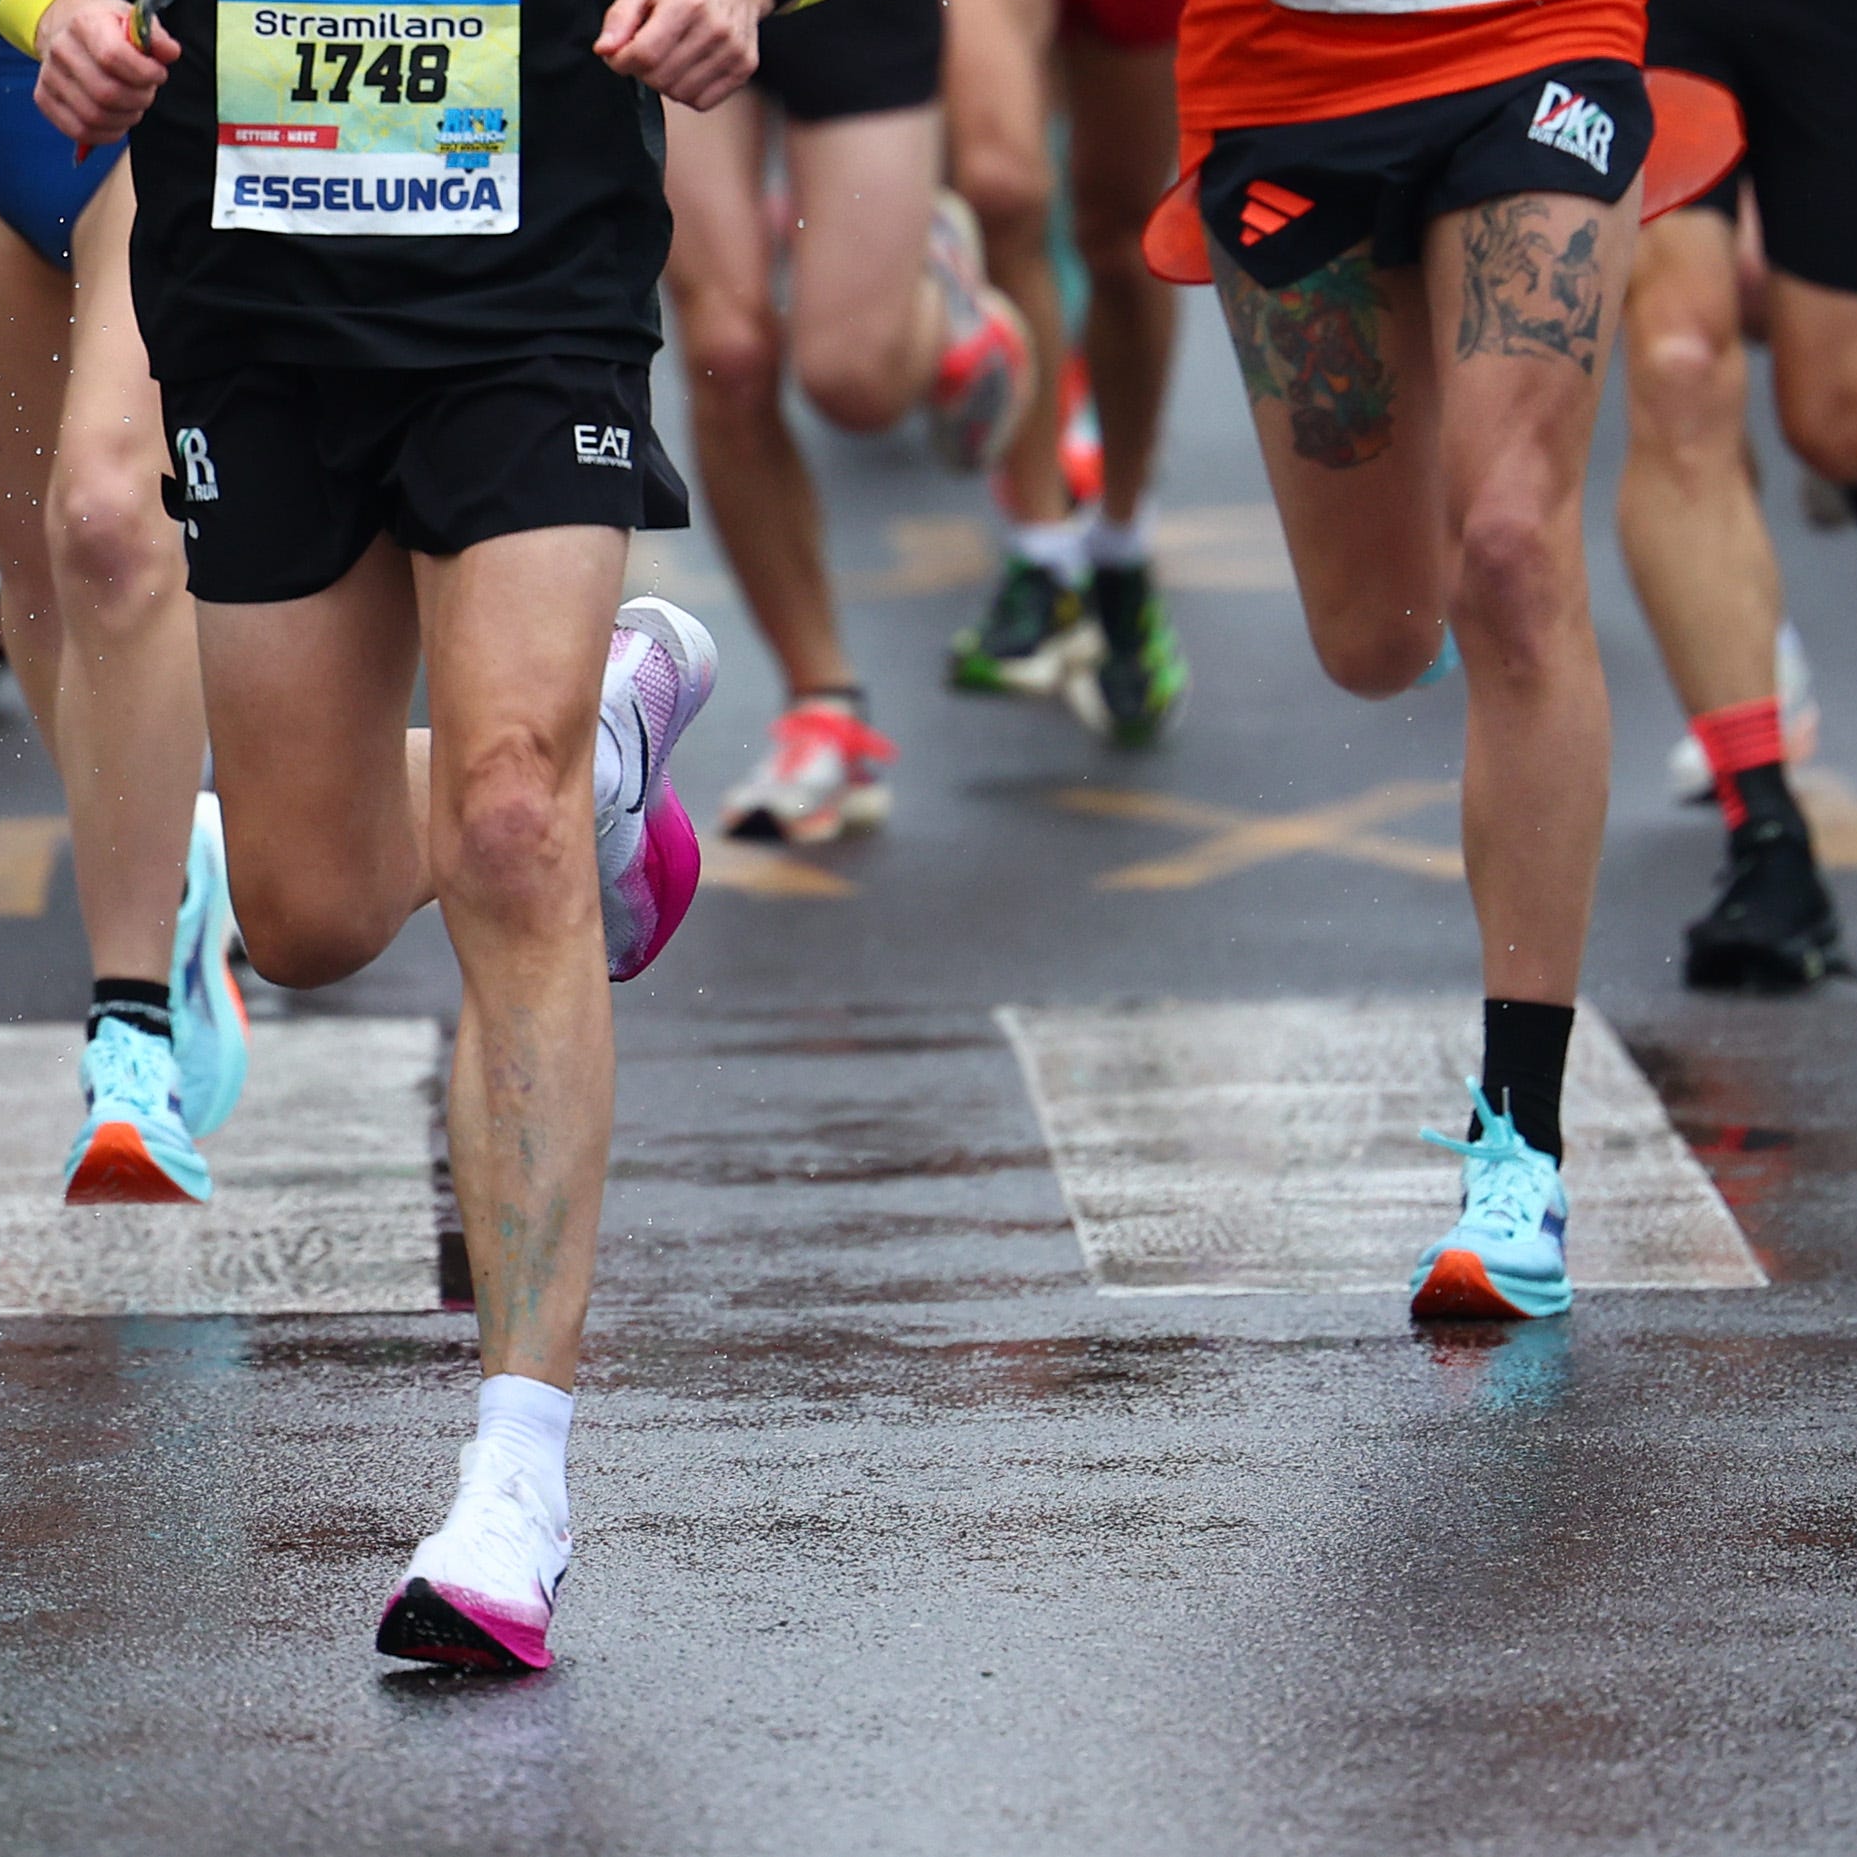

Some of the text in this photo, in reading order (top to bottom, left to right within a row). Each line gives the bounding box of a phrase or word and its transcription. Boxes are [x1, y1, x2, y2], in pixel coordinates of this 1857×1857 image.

[254, 9, 484, 39] Stramilano
[290, 42, 450, 104] 1748
[233, 174, 502, 212] ESSELUNGA
